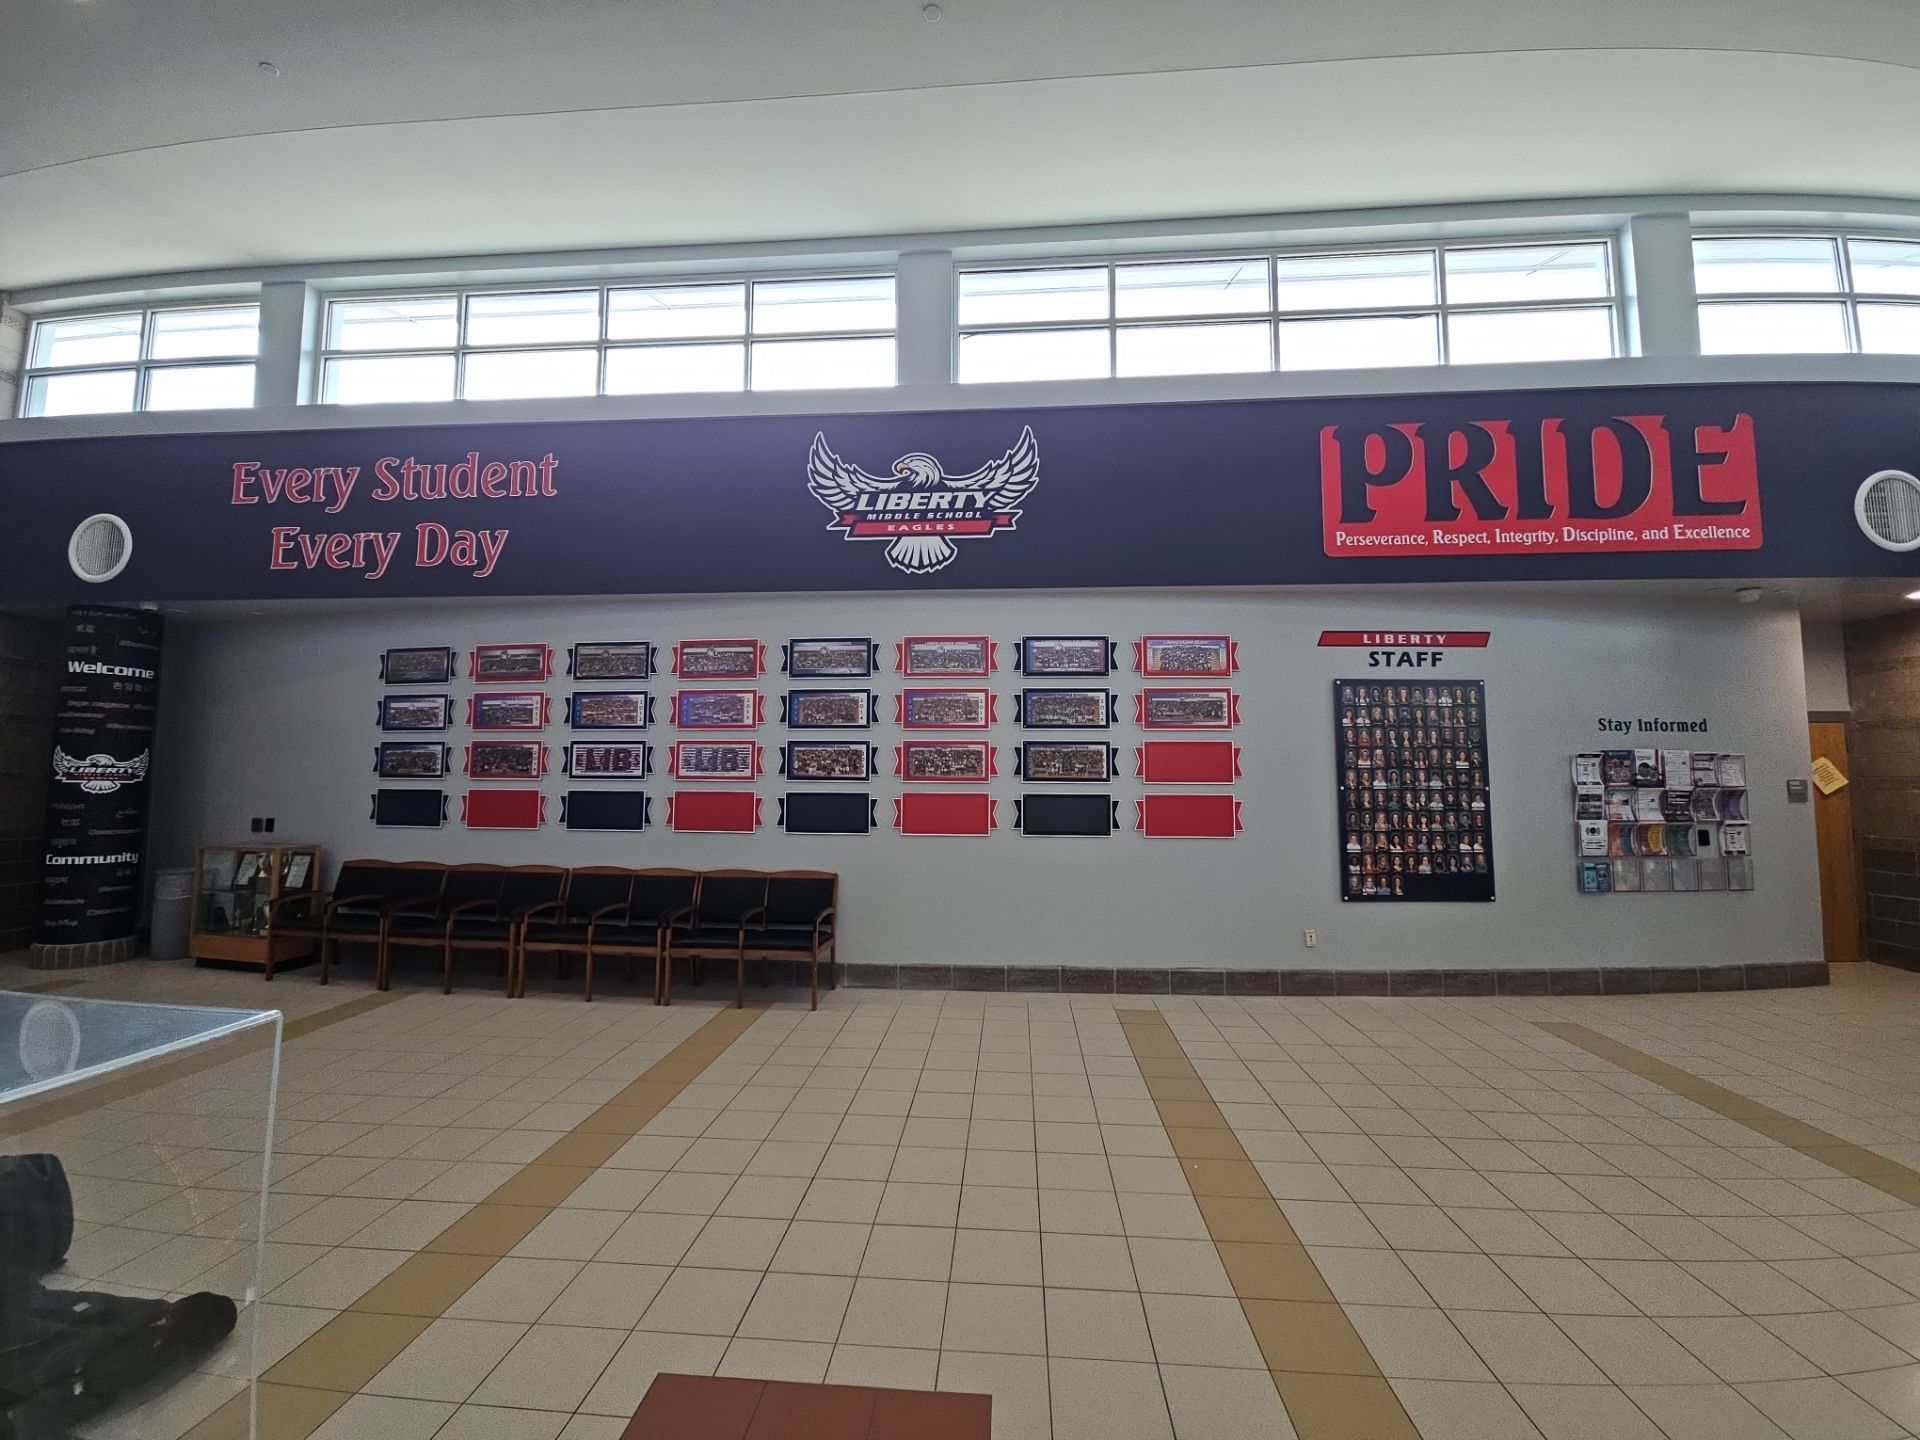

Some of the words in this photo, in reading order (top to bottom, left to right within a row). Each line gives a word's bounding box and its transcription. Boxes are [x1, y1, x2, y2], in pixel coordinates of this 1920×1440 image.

[1332, 413, 1748, 523] PRIDE
[231, 461, 360, 514] Every
[372, 451, 559, 501] Student
[856, 491, 996, 511] LIBERTY
[866, 512, 921, 521] MIDDLE
[927, 511, 982, 520] SCHOOL
[887, 523, 956, 532] EAGLES
[1335, 530, 1430, 547] Perseverance,
[1432, 529, 1492, 547] Respect,
[1495, 528, 1559, 545] Integrity,
[1562, 525, 1639, 544] Discipline,
[1642, 526, 1669, 540] and
[1673, 524, 1750, 540] Excellence
[270, 526, 401, 580] Every
[415, 522, 509, 578] Day
[1363, 633, 1449, 645] LIBERTY
[1368, 651, 1444, 668] STAFF
[68, 660, 155, 680] Welcome
[1598, 717, 1632, 735] Stay
[1637, 717, 1708, 733] Informed
[46, 850, 139, 867] Community
